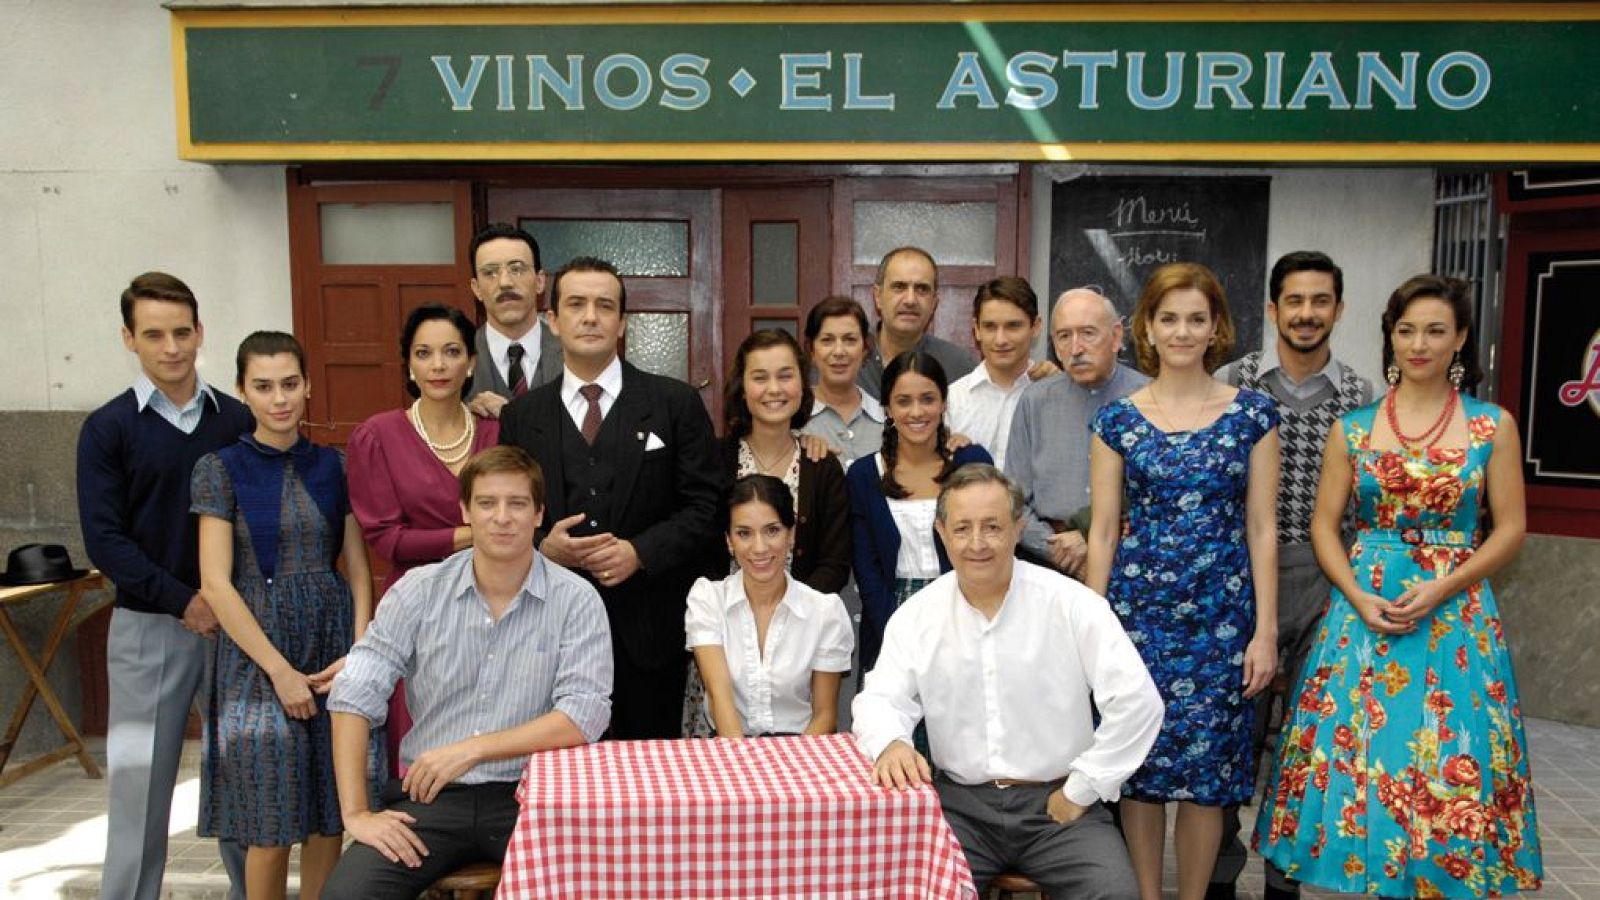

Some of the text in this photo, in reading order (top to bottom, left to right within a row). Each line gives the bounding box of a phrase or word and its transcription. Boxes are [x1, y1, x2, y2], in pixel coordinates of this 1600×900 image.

[357, 50, 1492, 112] 7 VINOS EL ASTURIANO
